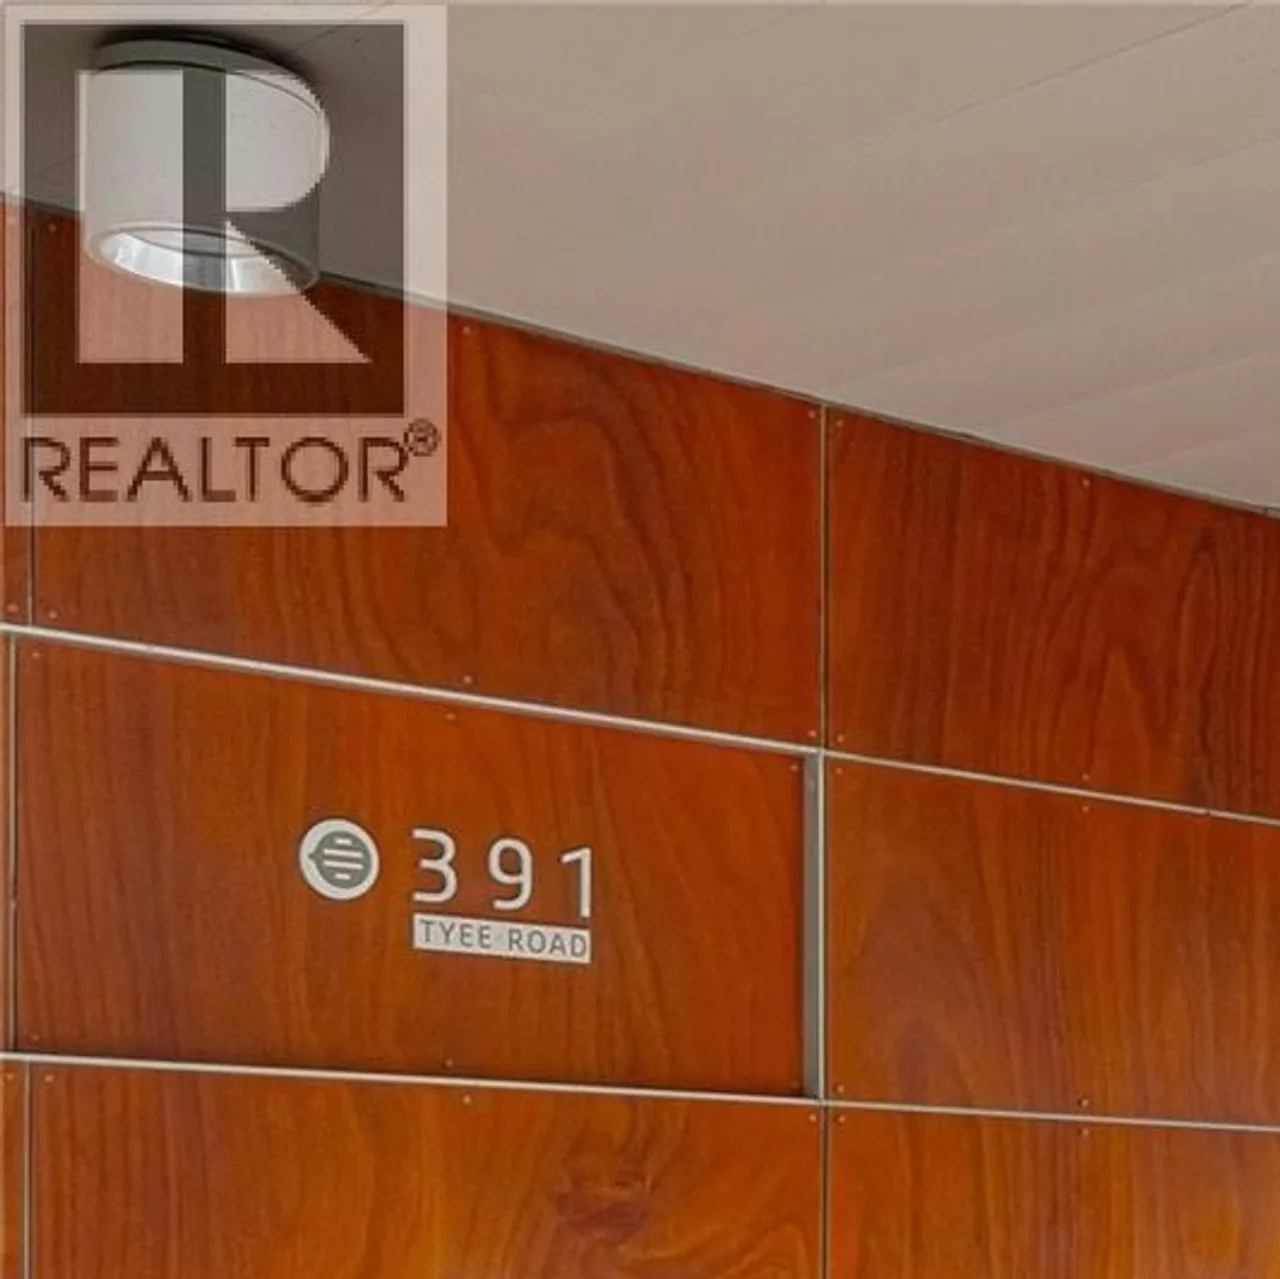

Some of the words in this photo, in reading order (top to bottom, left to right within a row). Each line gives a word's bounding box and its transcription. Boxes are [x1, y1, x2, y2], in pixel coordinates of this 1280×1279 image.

[412, 828, 592, 918] 391
[419, 919, 493, 949] TYEE
[507, 929, 588, 957] ROAD
